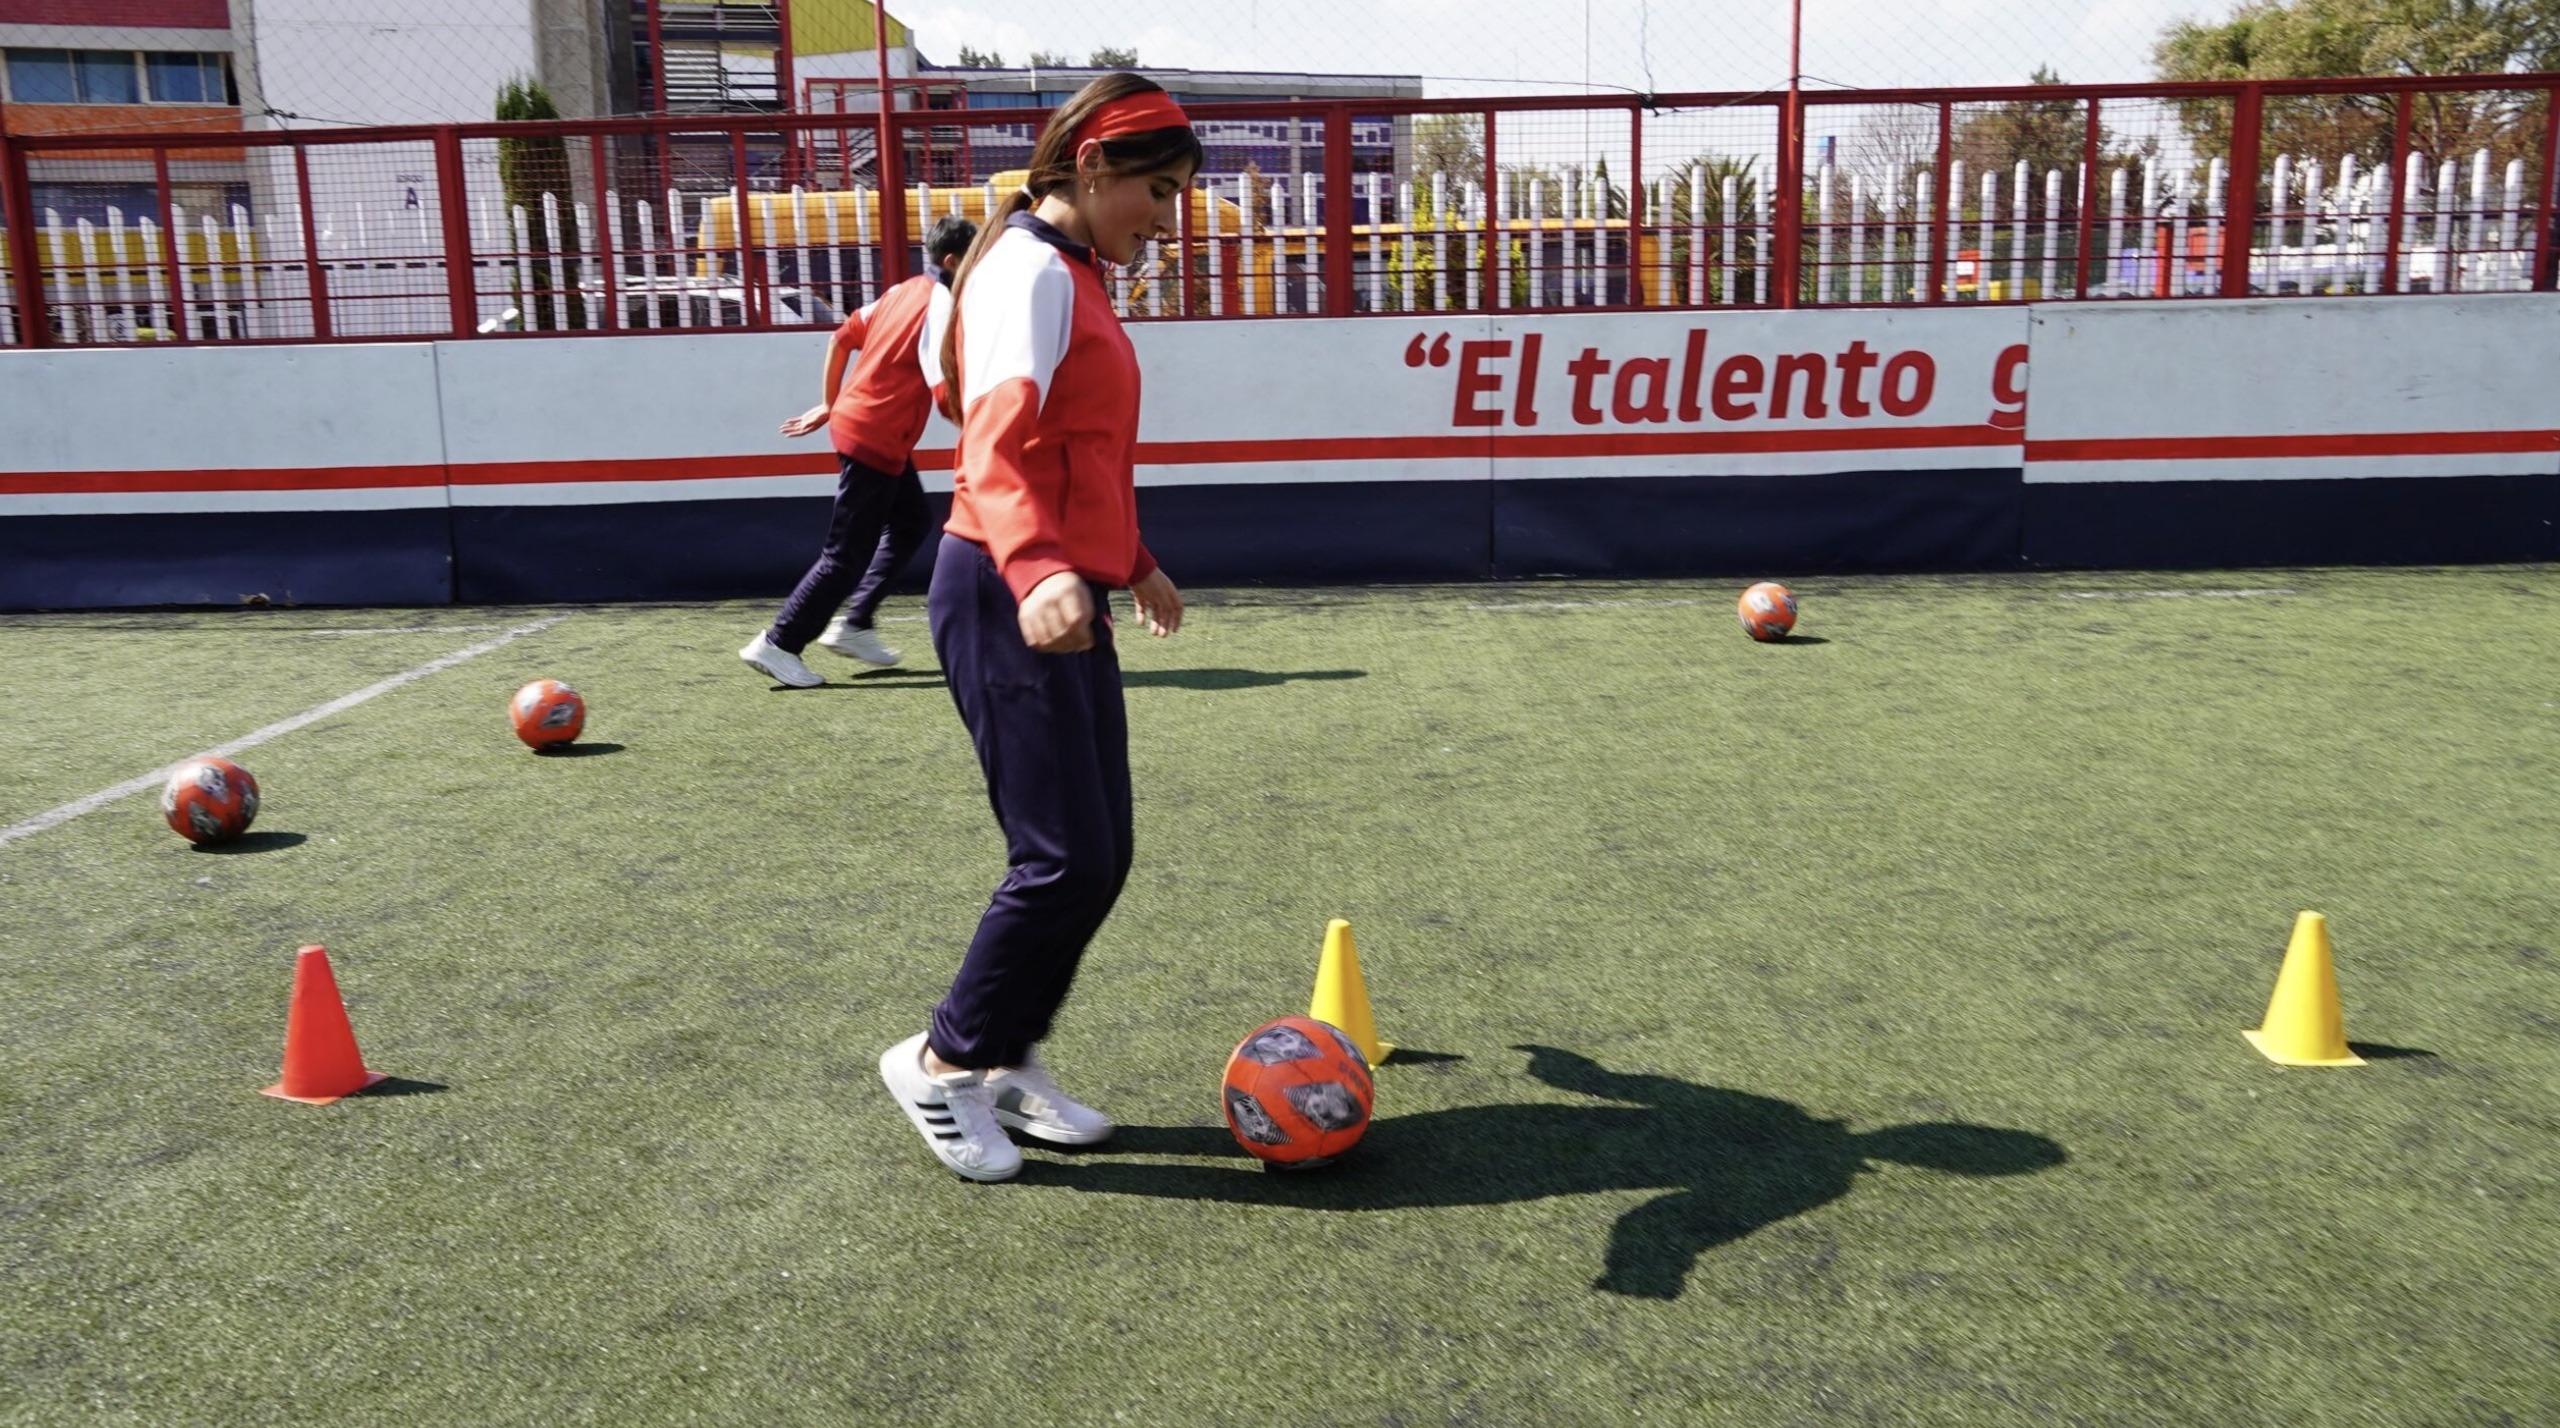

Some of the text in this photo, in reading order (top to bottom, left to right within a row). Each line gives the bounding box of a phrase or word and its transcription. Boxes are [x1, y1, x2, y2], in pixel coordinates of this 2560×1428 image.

[405, 186, 420, 209] A
[1404, 332, 1542, 427] “El
[1567, 328, 1936, 425] talento
